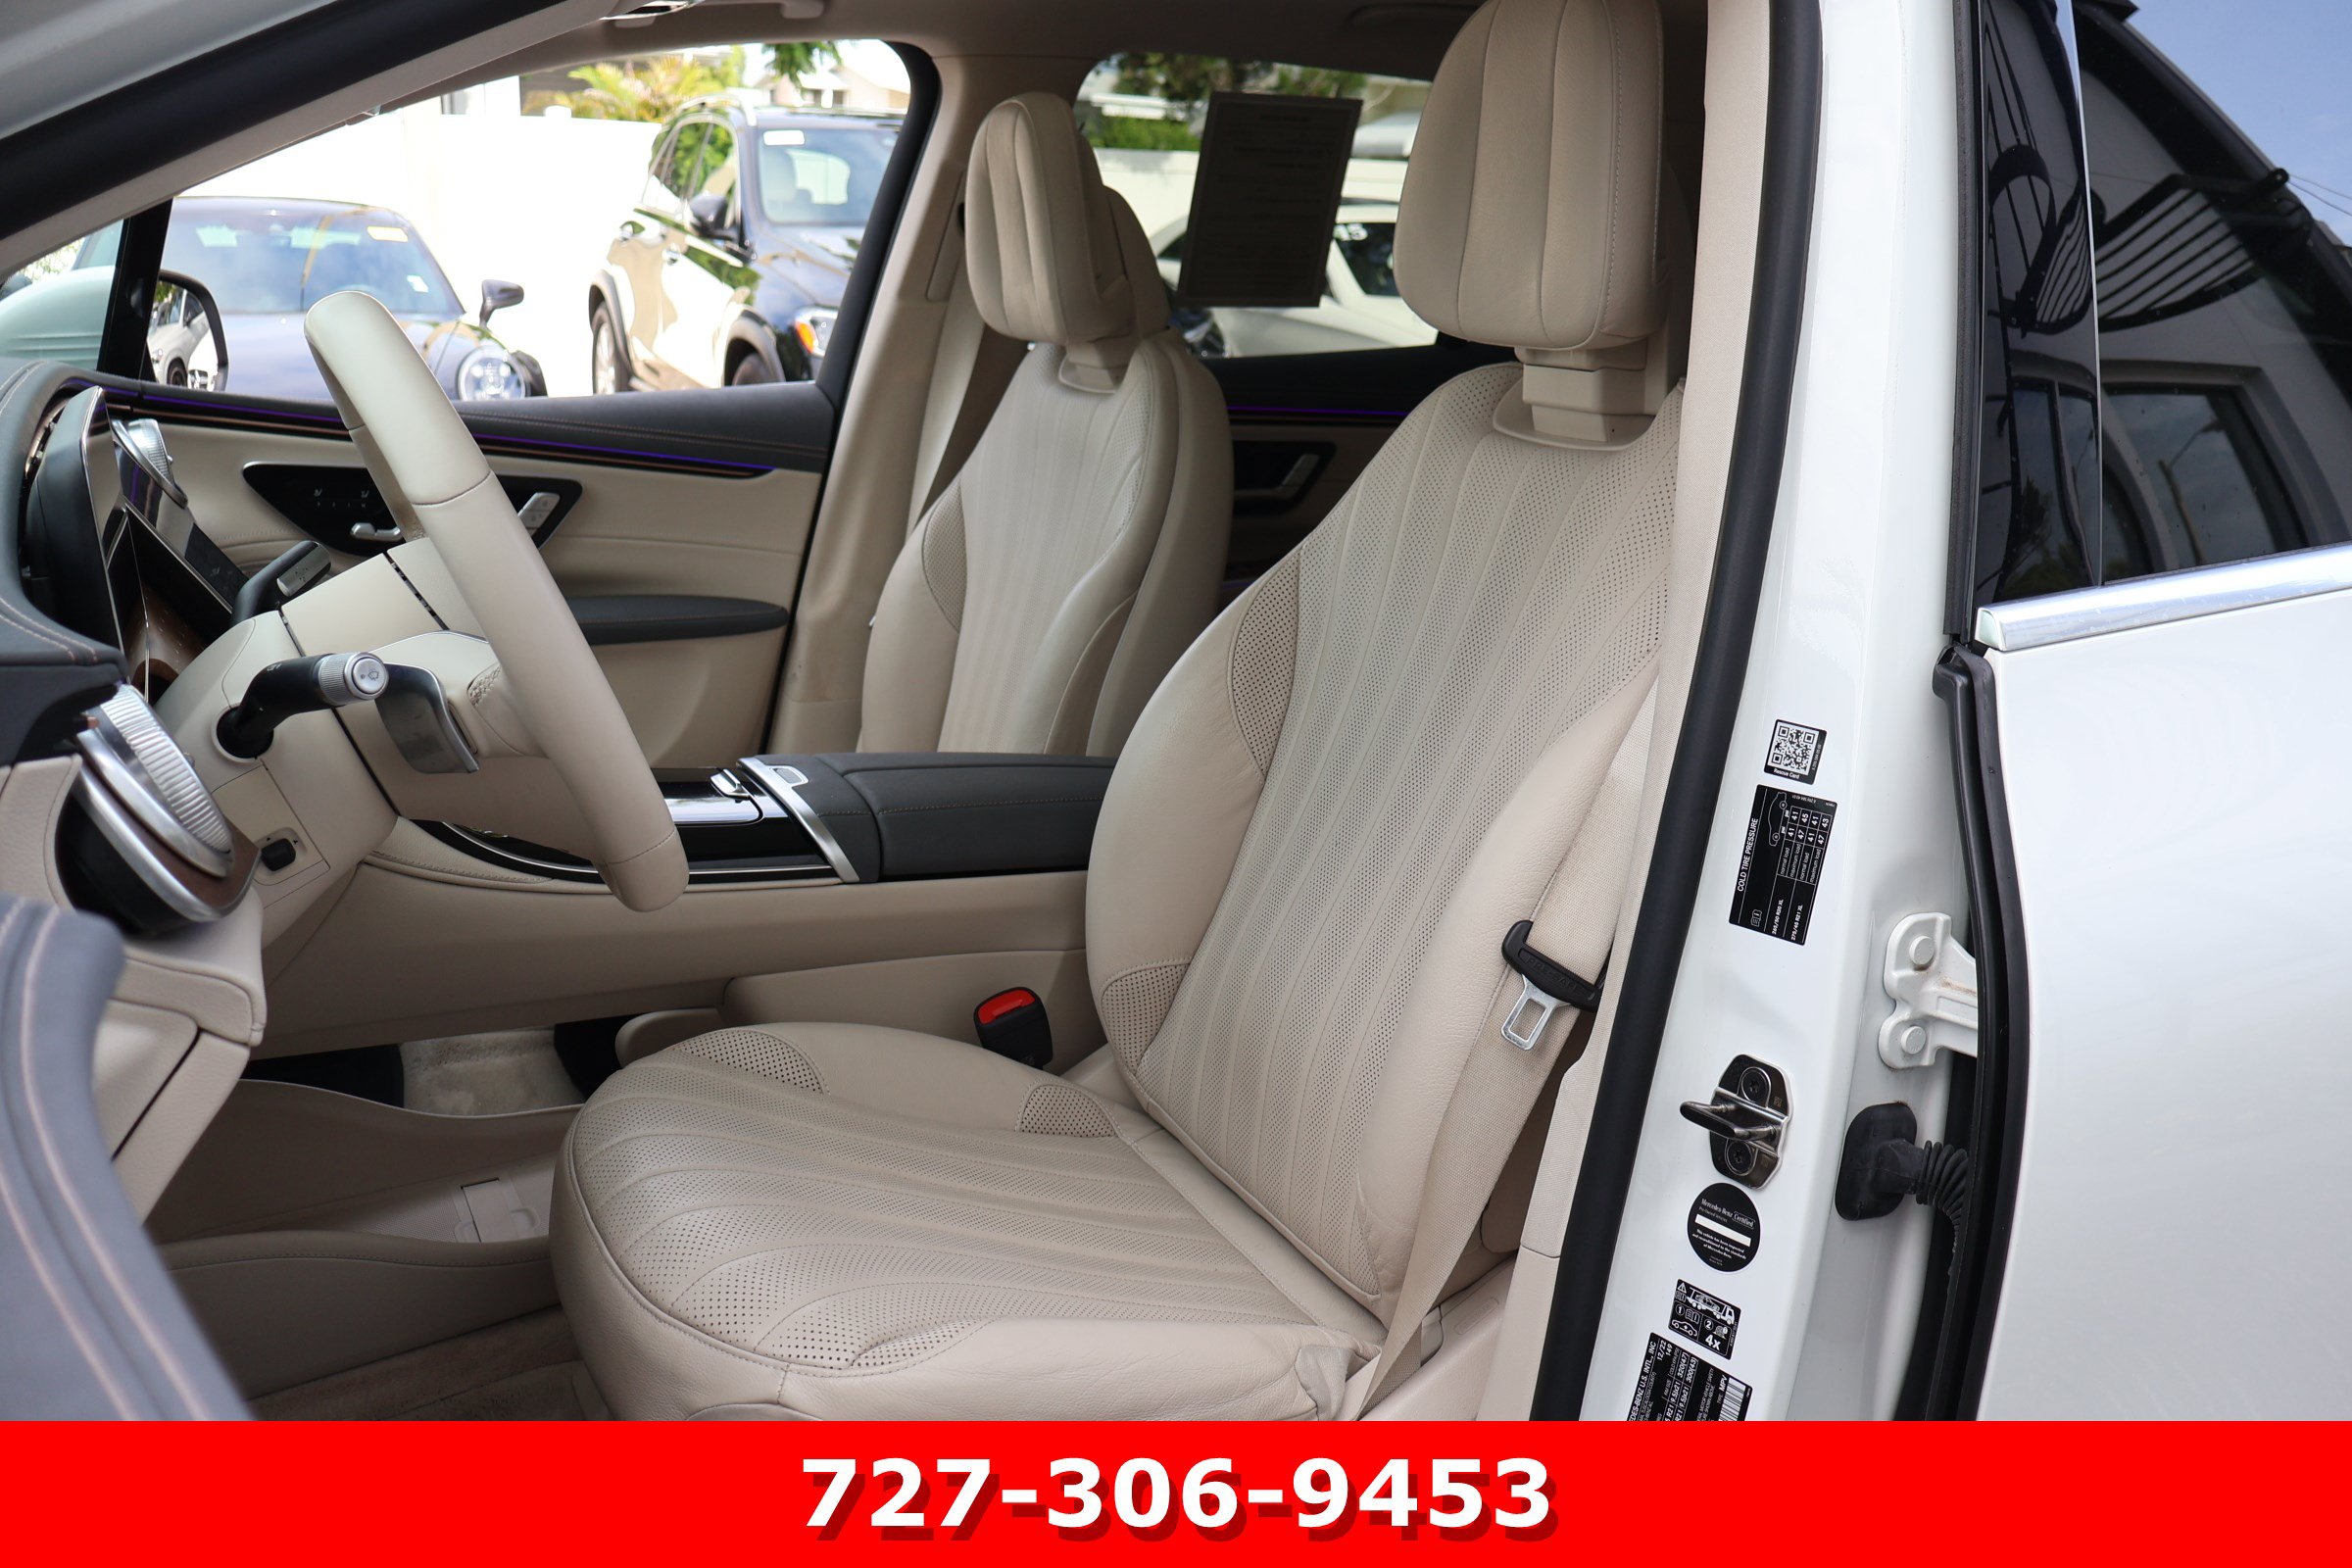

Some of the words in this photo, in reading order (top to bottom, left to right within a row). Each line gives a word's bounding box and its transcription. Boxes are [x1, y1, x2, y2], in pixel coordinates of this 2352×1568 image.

[1791, 811, 1798, 820] 41
[1745, 817, 1758, 855] PRESSURE
[1788, 827, 1795, 837] 41
[1807, 833, 1815, 842] 41
[1811, 816, 1819, 825] 41
[1789, 855, 1799, 877] maximum
[1797, 830, 1805, 839] 47
[1801, 813, 1809, 823] 45
[1809, 859, 1819, 882] maximum
[1818, 835, 1825, 845] 47
[1822, 818, 1829, 828] 43
[1741, 855, 1750, 871] TIRE
[1738, 872, 1746, 892] COLD
[1734, 1214, 1754, 1227] Certified
[1729, 1243, 1744, 1252] inspected
[1731, 1249, 1746, 1259] standards
[1657, 1341, 1666, 1360] 12/22
[1705, 1335, 1721, 1350] 4x
[1640, 1375, 1648, 1388] U.S.
[1671, 1382, 1681, 1402] 9.5Jx21
[1678, 1352, 1690, 1378] 320(47)
[1719, 1374, 1728, 1392] MPV
[1679, 1387, 1690, 1407] 9.5Jx21
